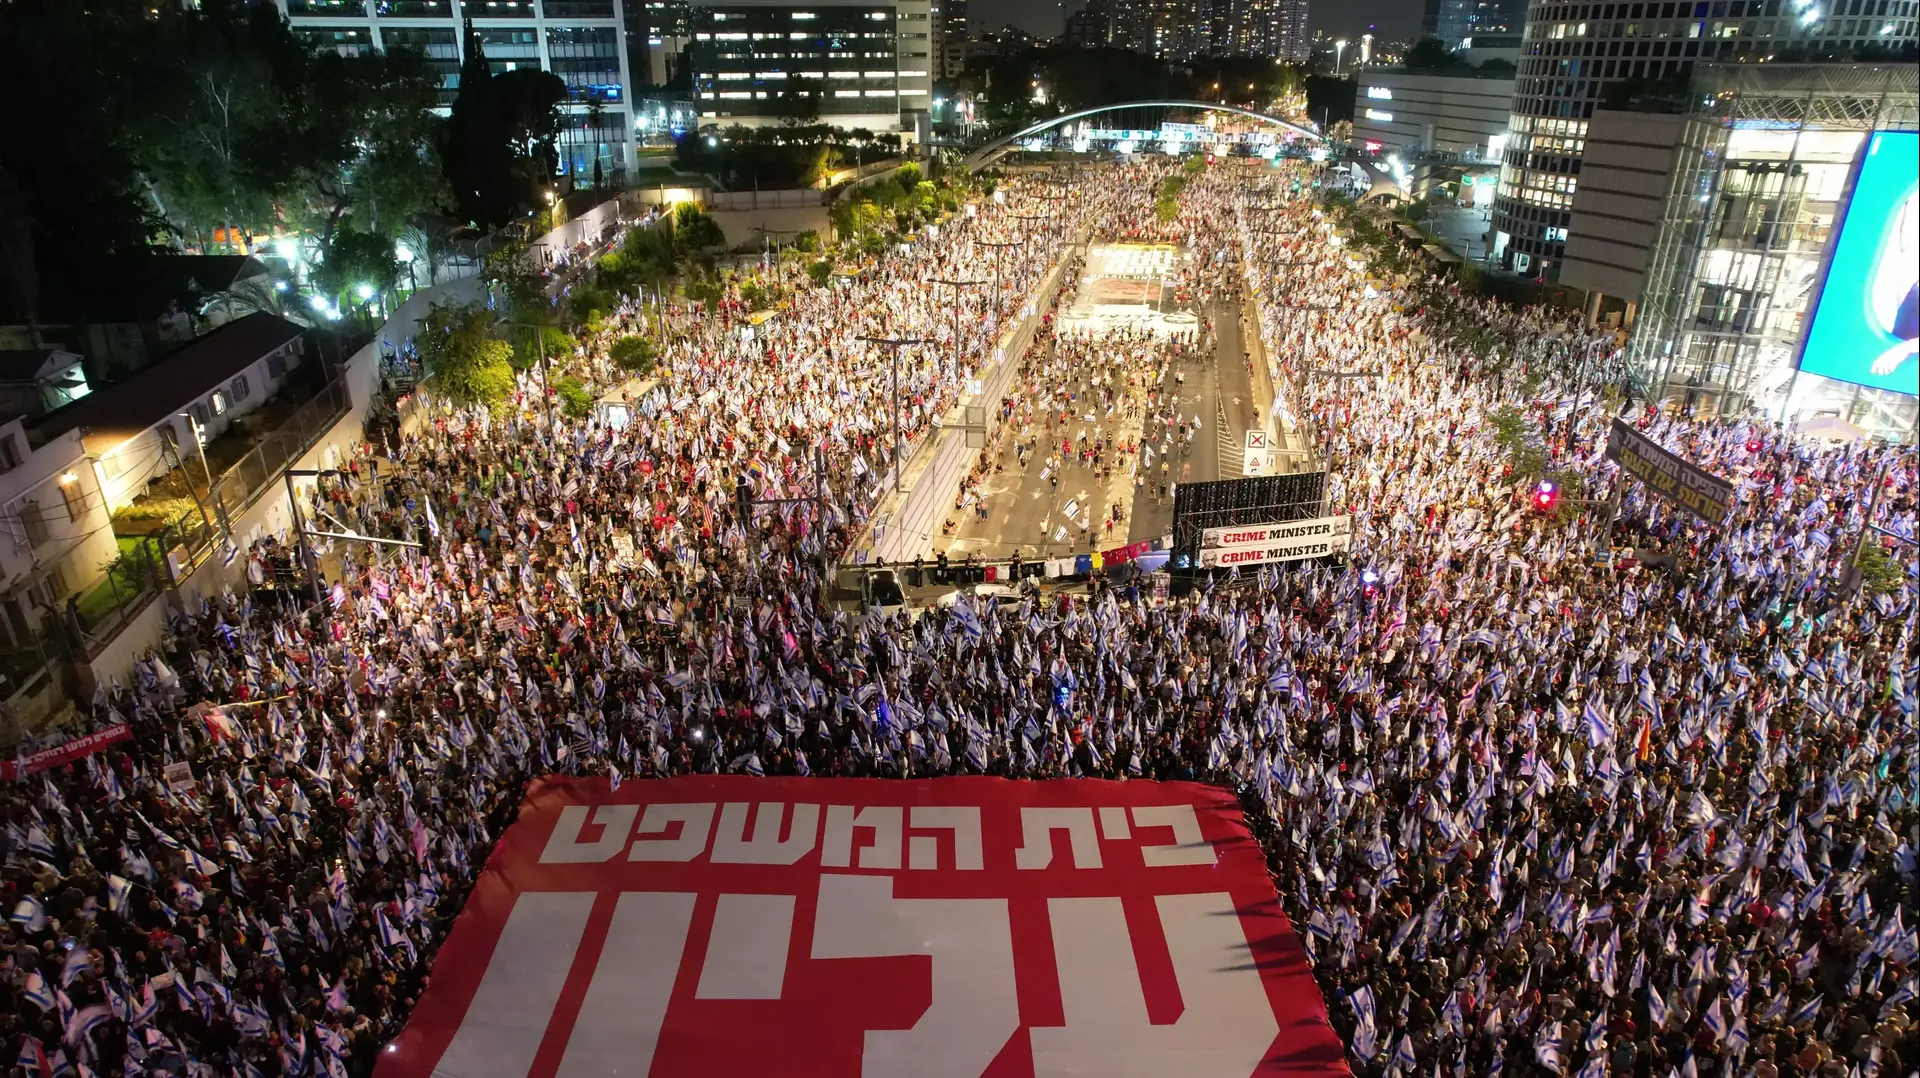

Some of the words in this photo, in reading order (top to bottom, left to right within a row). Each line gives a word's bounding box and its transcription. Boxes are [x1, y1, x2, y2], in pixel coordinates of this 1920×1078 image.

[1651, 470, 1677, 494] את
[1682, 466, 1730, 504] ההפיכה
[1223, 530, 1267, 544] CRIME
[1268, 524, 1331, 540] MINISTER
[1221, 550, 1265, 564] CRIME
[1266, 543, 1328, 559] MINISTER
[538, 802, 984, 870] המשפט
[1015, 804, 1218, 870] בית
[430, 873, 1281, 1078] עליון
